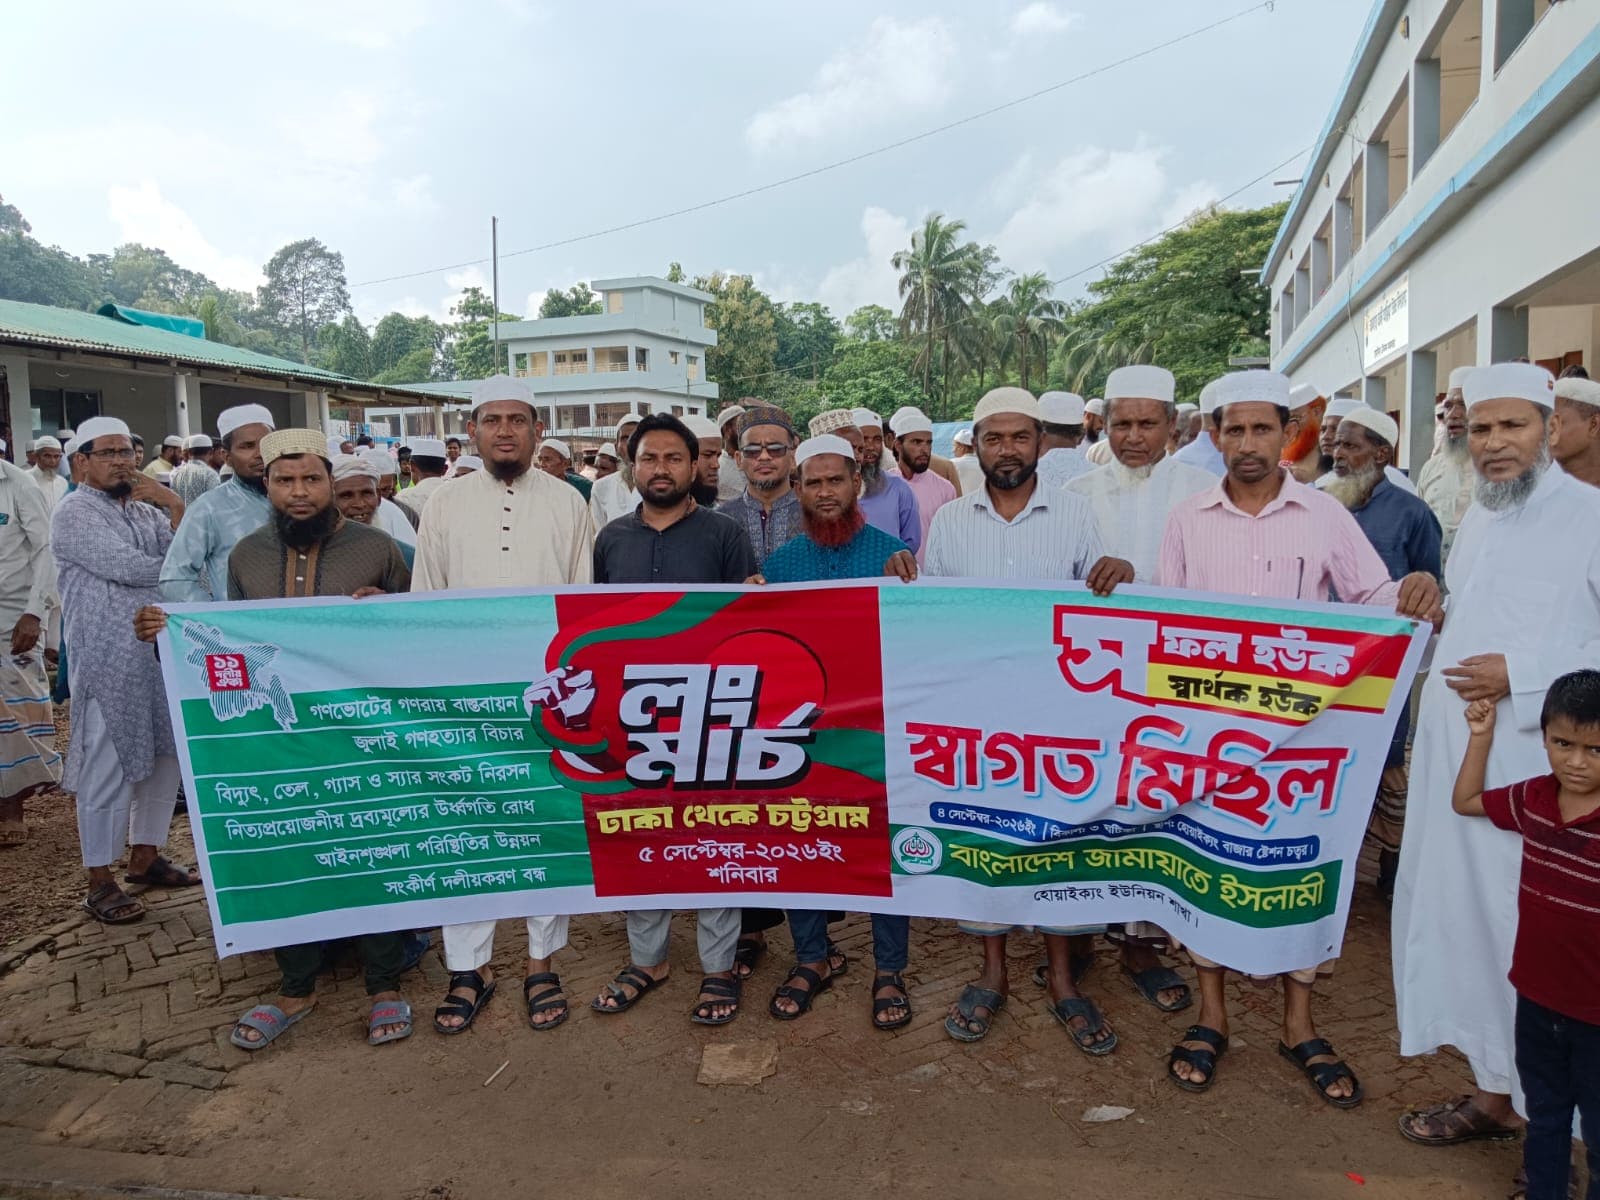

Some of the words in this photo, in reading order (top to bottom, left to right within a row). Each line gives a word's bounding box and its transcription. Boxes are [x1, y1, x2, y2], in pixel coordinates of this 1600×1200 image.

[213, 655, 239, 669] ১১
[1250, 626, 1355, 678] হউক
[310, 694, 393, 720] গণভোটের
[398, 697, 447, 714] গণরায়
[452, 695, 518, 713] বাস্তবায়ন
[619, 664, 759, 729] লং
[1168, 671, 1251, 705] স্বার্থক
[1257, 682, 1322, 717] হউক
[352, 730, 400, 754] জুলাই
[405, 727, 477, 749] গণহত্যার
[481, 723, 524, 742] বিচার
[625, 702, 817, 784] মার্চ
[324, 775, 362, 794] গ্যাস
[367, 774, 382, 788] ও
[425, 765, 474, 786] সংকট
[477, 761, 531, 784] নিরসন
[905, 721, 1101, 796] স্বাগত
[1115, 714, 1349, 826] মিছিল
[224, 810, 345, 840] নিত্যপ্রয়োজনীয়
[349, 803, 431, 829] দ্রব্যমূল্যের
[501, 799, 536, 815] রোধ
[596, 806, 674, 834] ঢাকা
[682, 803, 760, 828] থেকে
[765, 797, 870, 832] চট্টগ্রাম
[937, 808, 945, 818] ৪
[1222, 840, 1254, 858] বাজার
[416, 832, 490, 856] পরিস্থিতির
[493, 830, 542, 850] উন্নয়ন
[639, 847, 654, 863] ৫
[383, 872, 436, 896] সংকীর্ণ
[440, 867, 517, 889] দলীয়করণ
[520, 866, 548, 883] বন্ধ
[705, 861, 779, 884] শনিবার
[949, 843, 1075, 877] বাংলাদেশ
[1082, 848, 1213, 894] জামায়াতে
[1219, 872, 1326, 912] ইসলামী
[1034, 886, 1105, 902] হোয়াইক্যং
[1108, 884, 1165, 905] ইউনিয়ন
